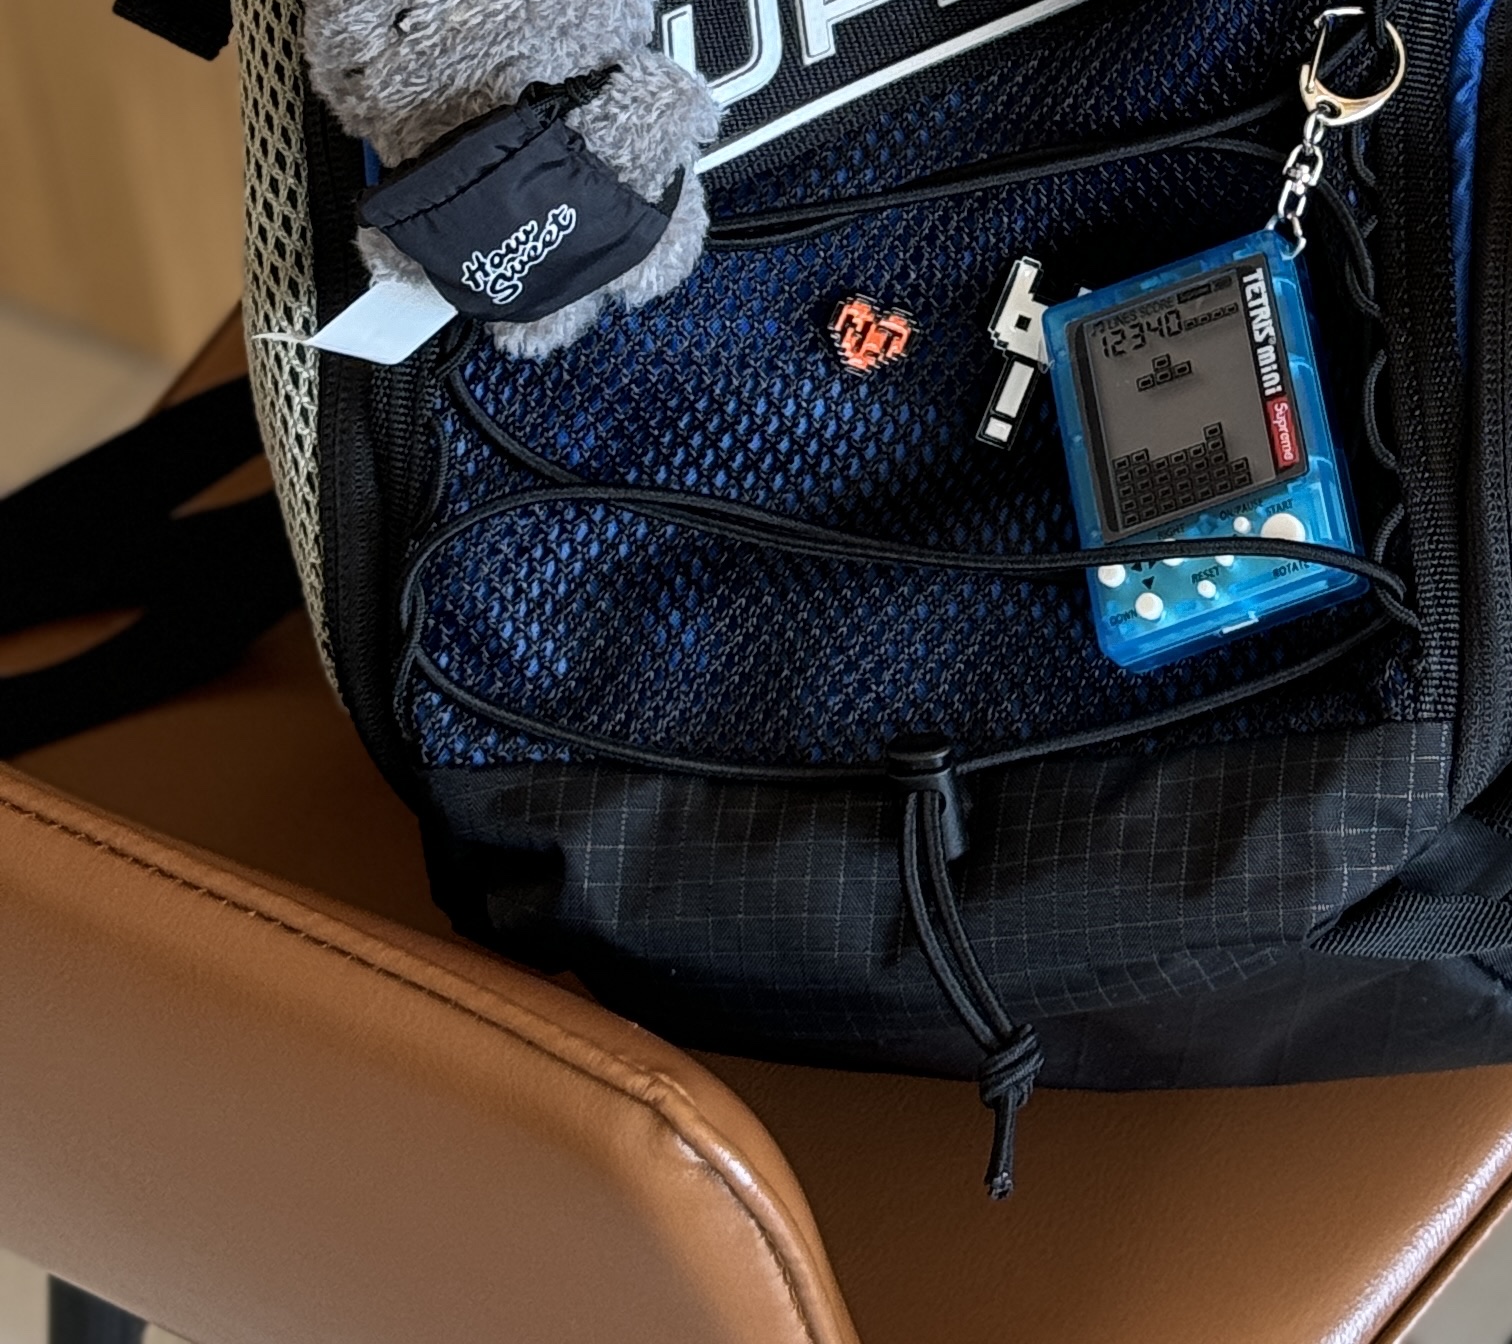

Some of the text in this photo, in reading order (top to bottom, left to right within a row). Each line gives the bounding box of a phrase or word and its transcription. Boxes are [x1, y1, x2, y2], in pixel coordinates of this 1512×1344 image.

[461, 220, 538, 292] How
[486, 203, 577, 305] Sweet
[1256, 345, 1283, 397] mini
[1272, 402, 1294, 462] Supreme
[1264, 498, 1294, 516] START
[1190, 565, 1221, 585] RESET
[1108, 608, 1138, 628] DOWN
